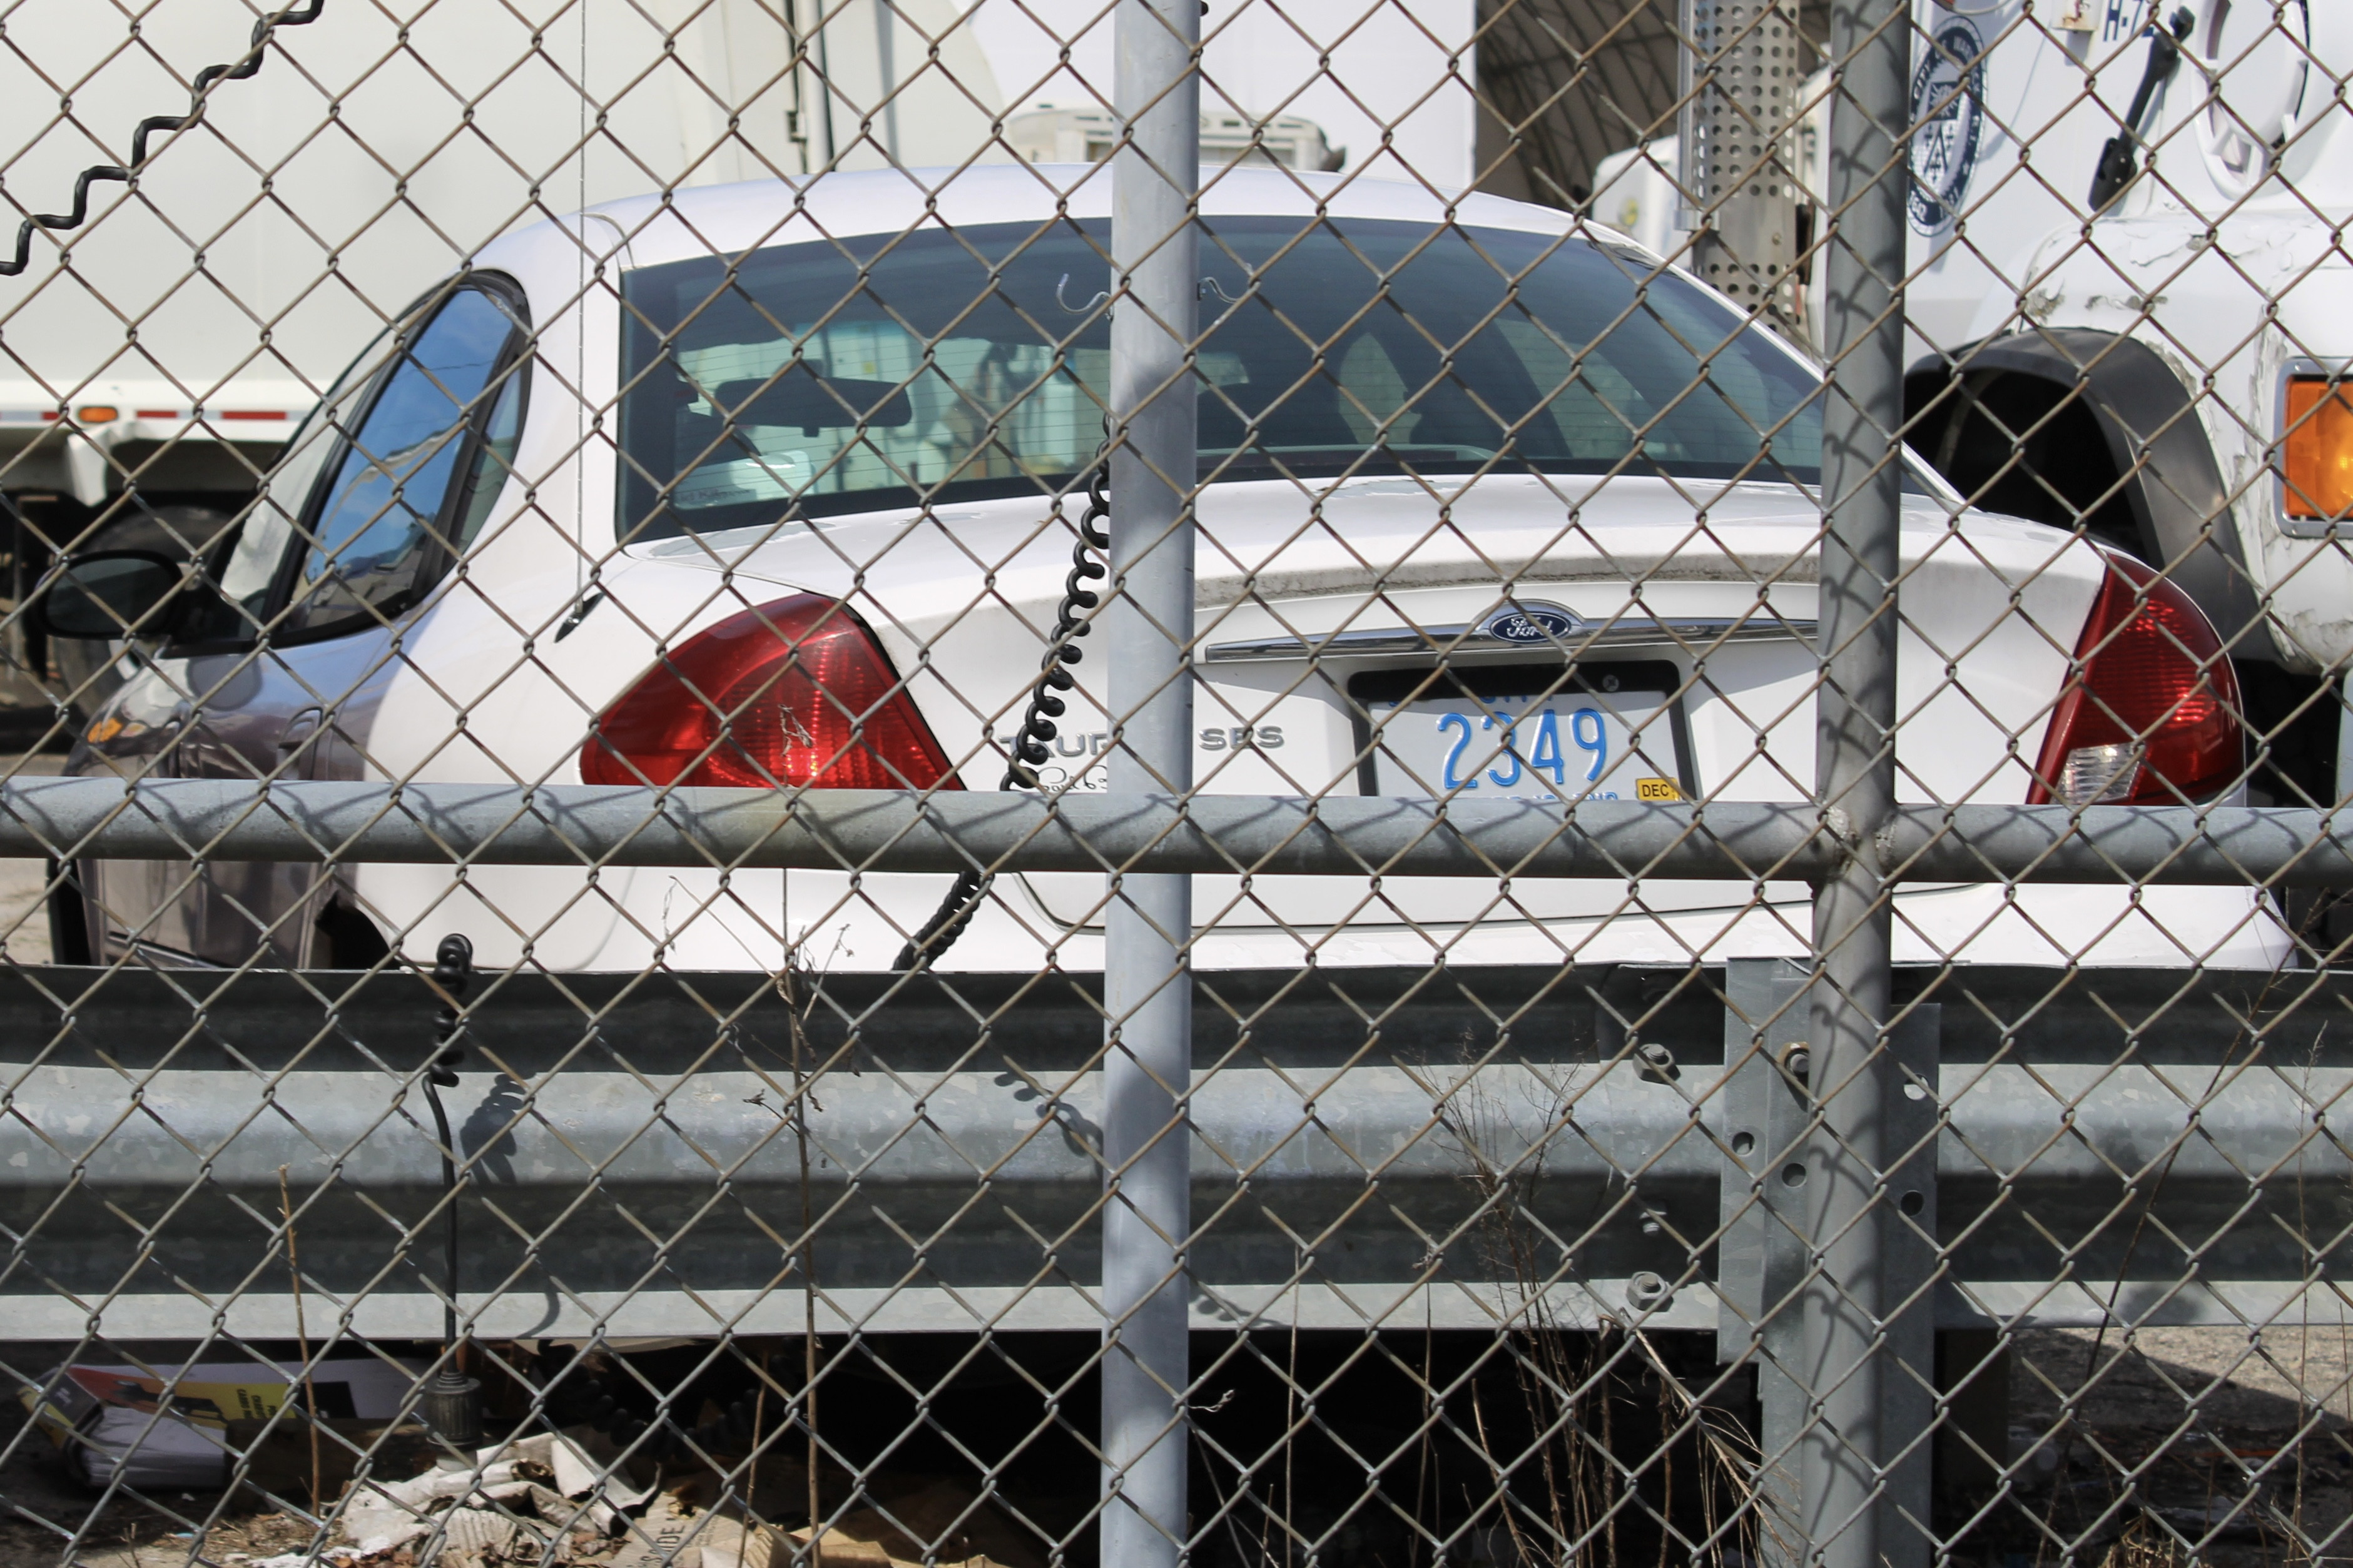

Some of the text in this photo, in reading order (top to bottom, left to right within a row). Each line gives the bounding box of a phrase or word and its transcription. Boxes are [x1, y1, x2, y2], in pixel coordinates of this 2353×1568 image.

[1506, 615, 1553, 638] Ford
[1198, 725, 1285, 751] SES
[1437, 707, 1607, 789] 2349
[1642, 784, 1669, 797] DEC
